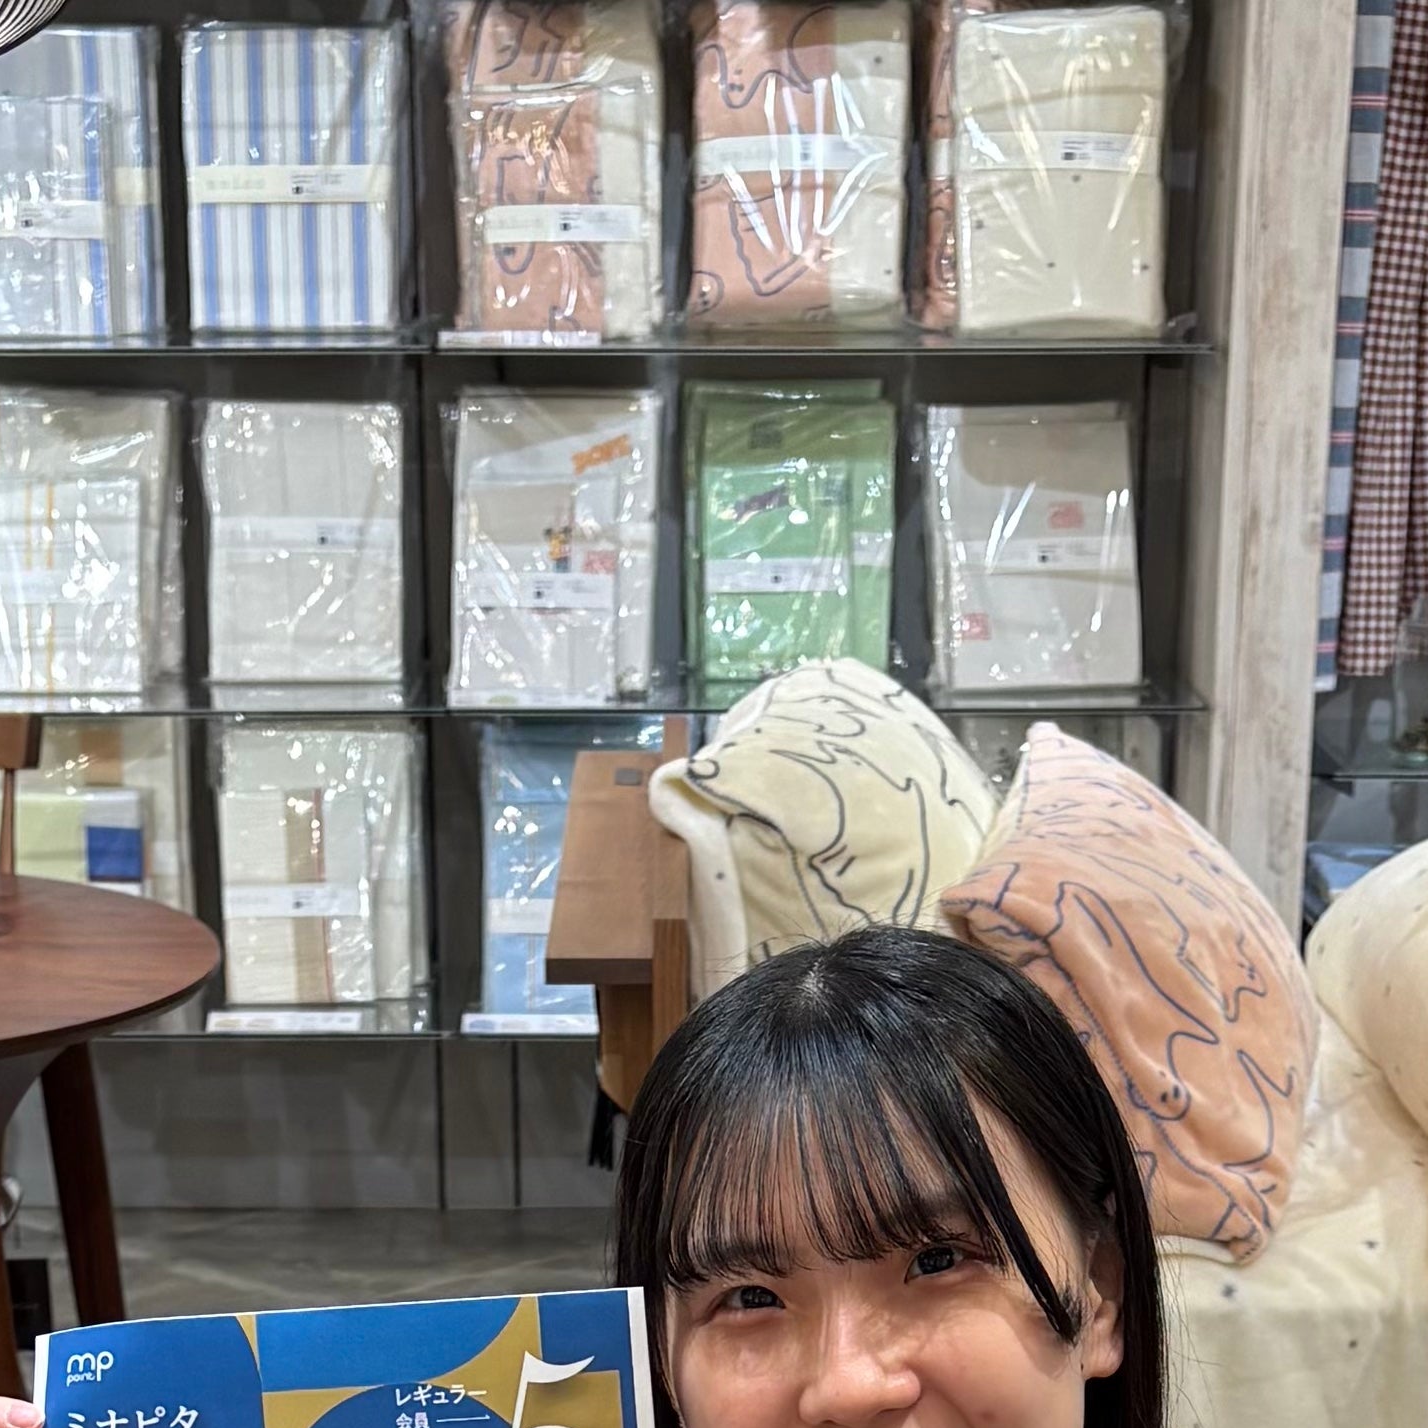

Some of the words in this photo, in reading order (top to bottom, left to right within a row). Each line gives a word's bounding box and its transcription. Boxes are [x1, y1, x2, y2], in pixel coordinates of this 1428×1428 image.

[394, 1384, 487, 1406] レギュラー
